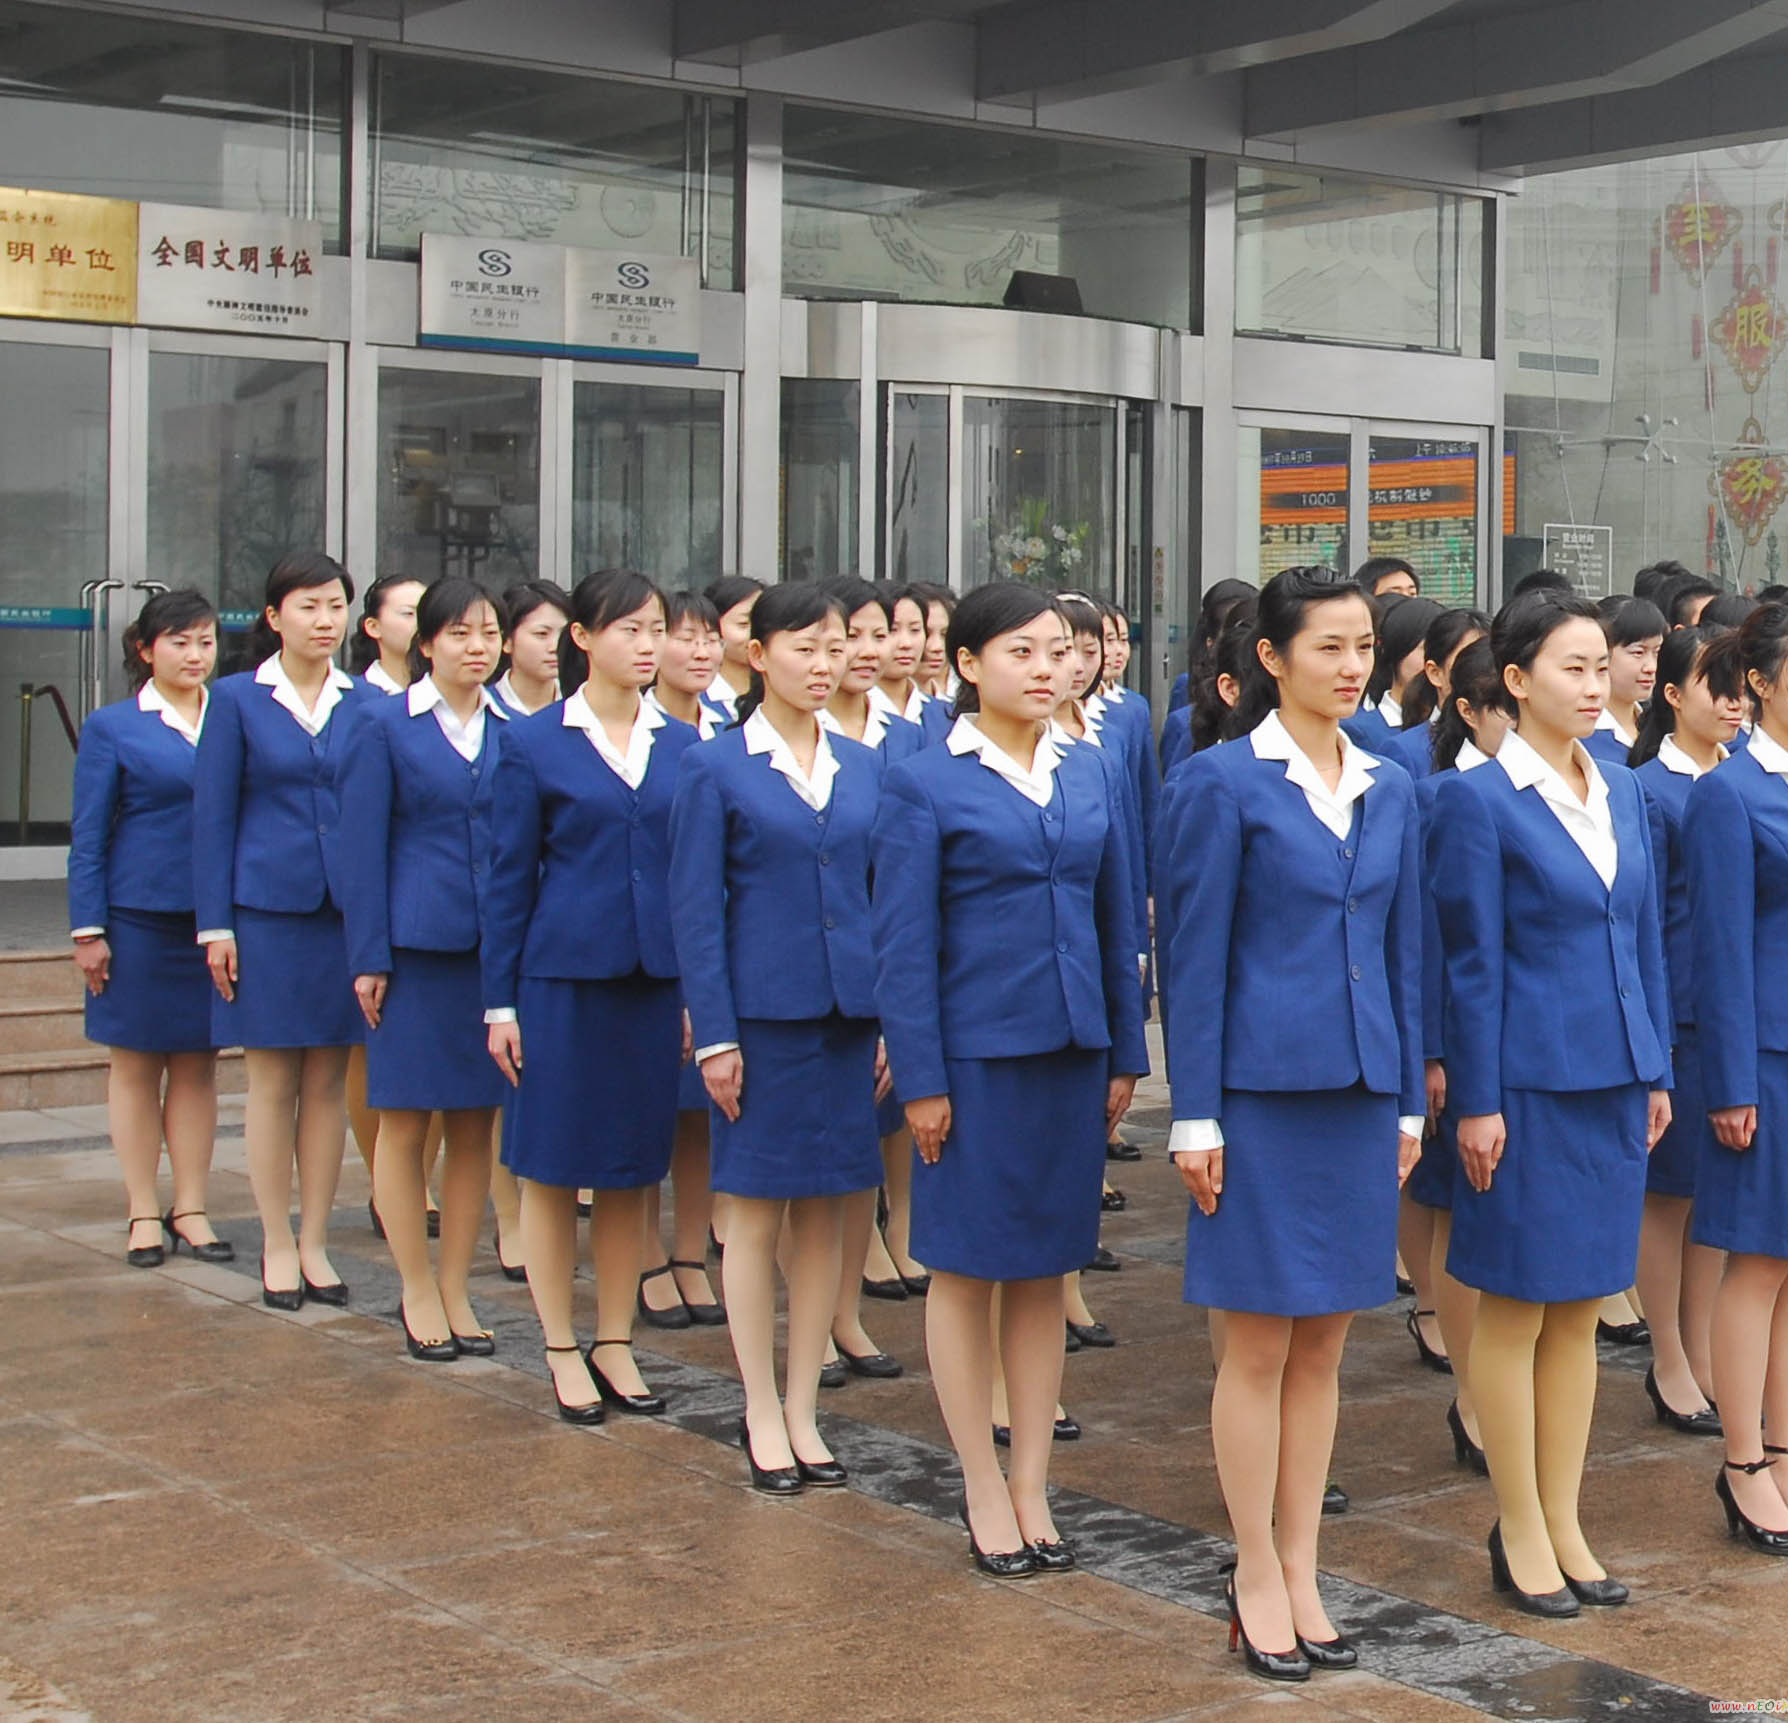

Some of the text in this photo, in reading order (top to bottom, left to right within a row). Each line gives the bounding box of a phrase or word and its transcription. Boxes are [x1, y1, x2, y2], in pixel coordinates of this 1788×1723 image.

[1679, 203, 1717, 245] 至
[7, 241, 115, 271] 明单位
[152, 236, 313, 278] 全国文明单位
[450, 280, 540, 298] 中国民生银行
[591, 291, 676, 308] 中国民生银行
[1734, 302, 1771, 349] 服
[1301, 487, 1336, 506] 1000
[1731, 458, 1777, 504] 务
